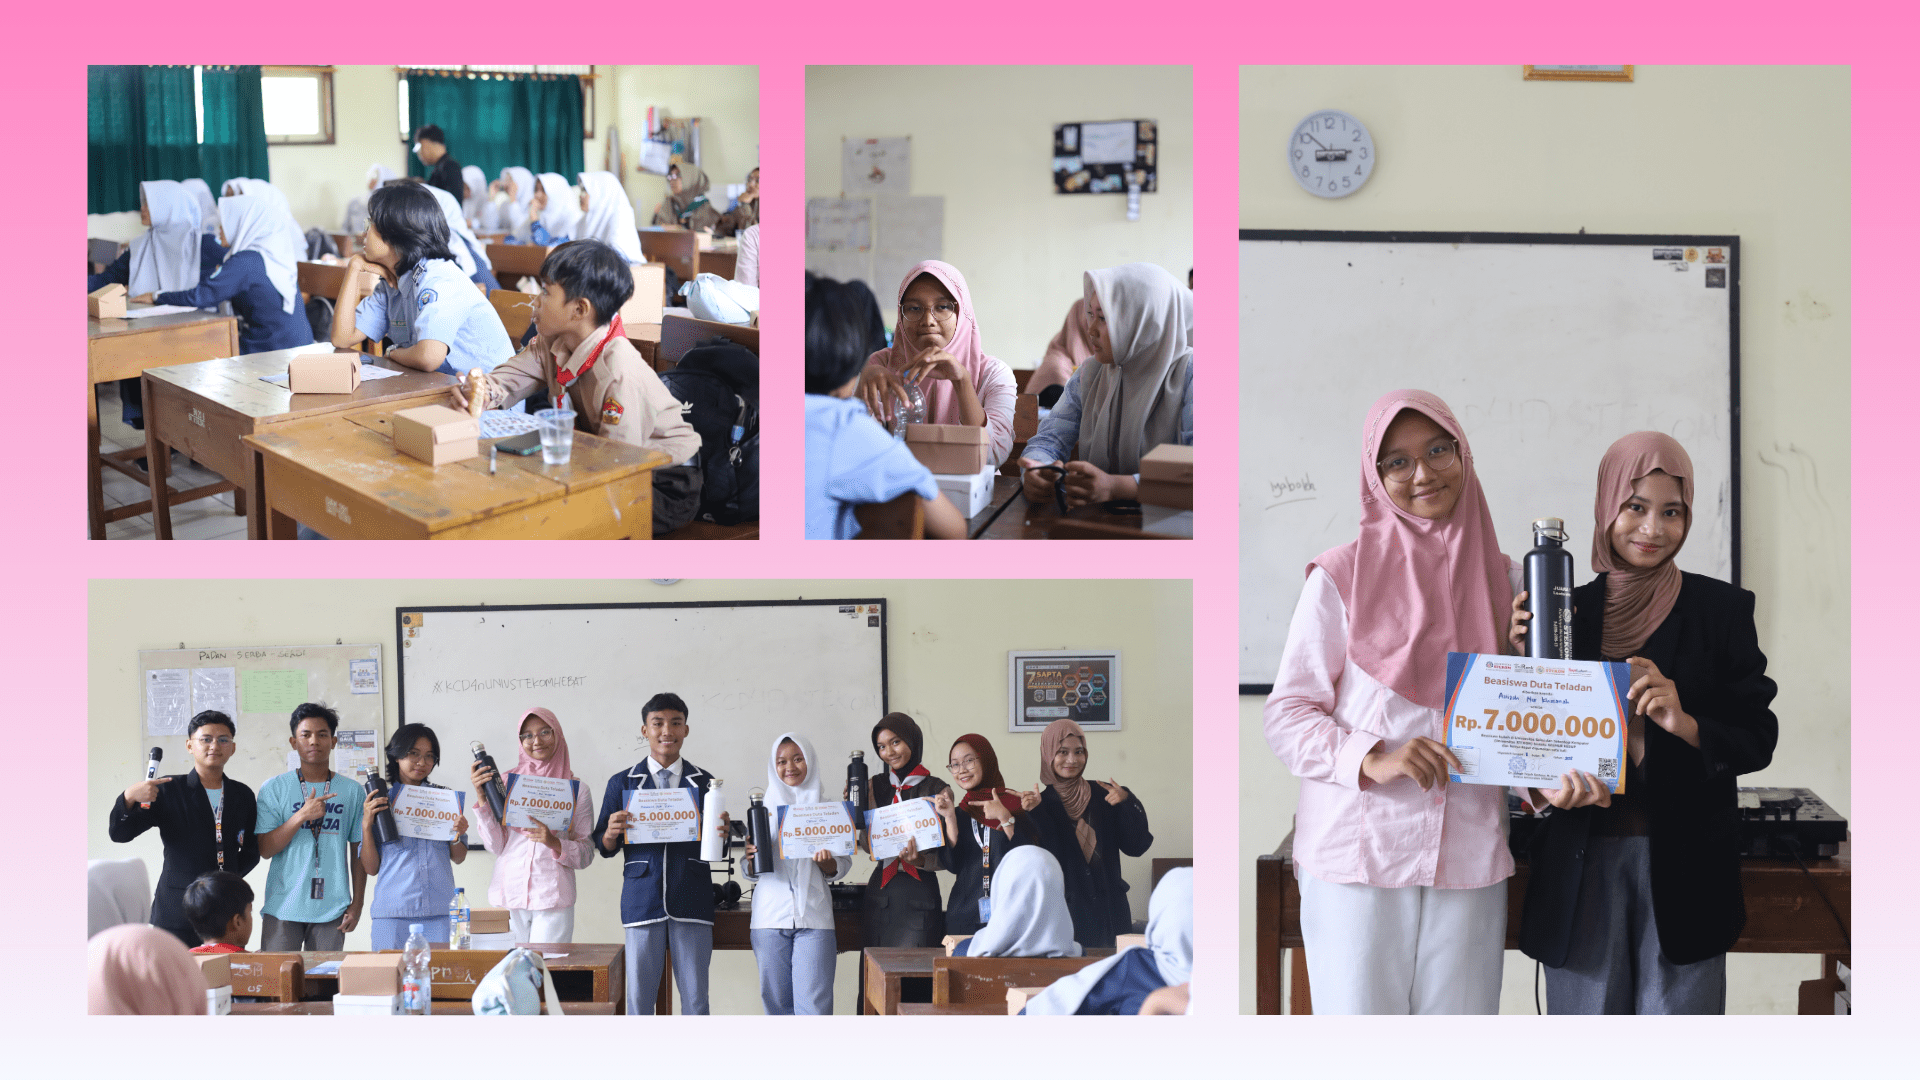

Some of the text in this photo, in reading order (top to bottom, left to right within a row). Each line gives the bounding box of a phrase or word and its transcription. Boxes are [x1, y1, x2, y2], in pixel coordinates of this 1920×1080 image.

[1310, 120, 1319, 132] 11
[1324, 117, 1335, 130] 12
[1342, 119, 1346, 131] 1
[1300, 131, 1312, 144] 10
[1352, 129, 1361, 142] 2
[1295, 149, 1302, 160] 9
[1360, 147, 1367, 159] 3
[1302, 165, 1310, 178] 8
[1354, 164, 1362, 176] 4
[1316, 176, 1323, 188] 7
[1328, 180, 1337, 192] 6
[1342, 176, 1351, 188] 5
[1484, 676, 1592, 692] Beasiswa Duta Teladan
